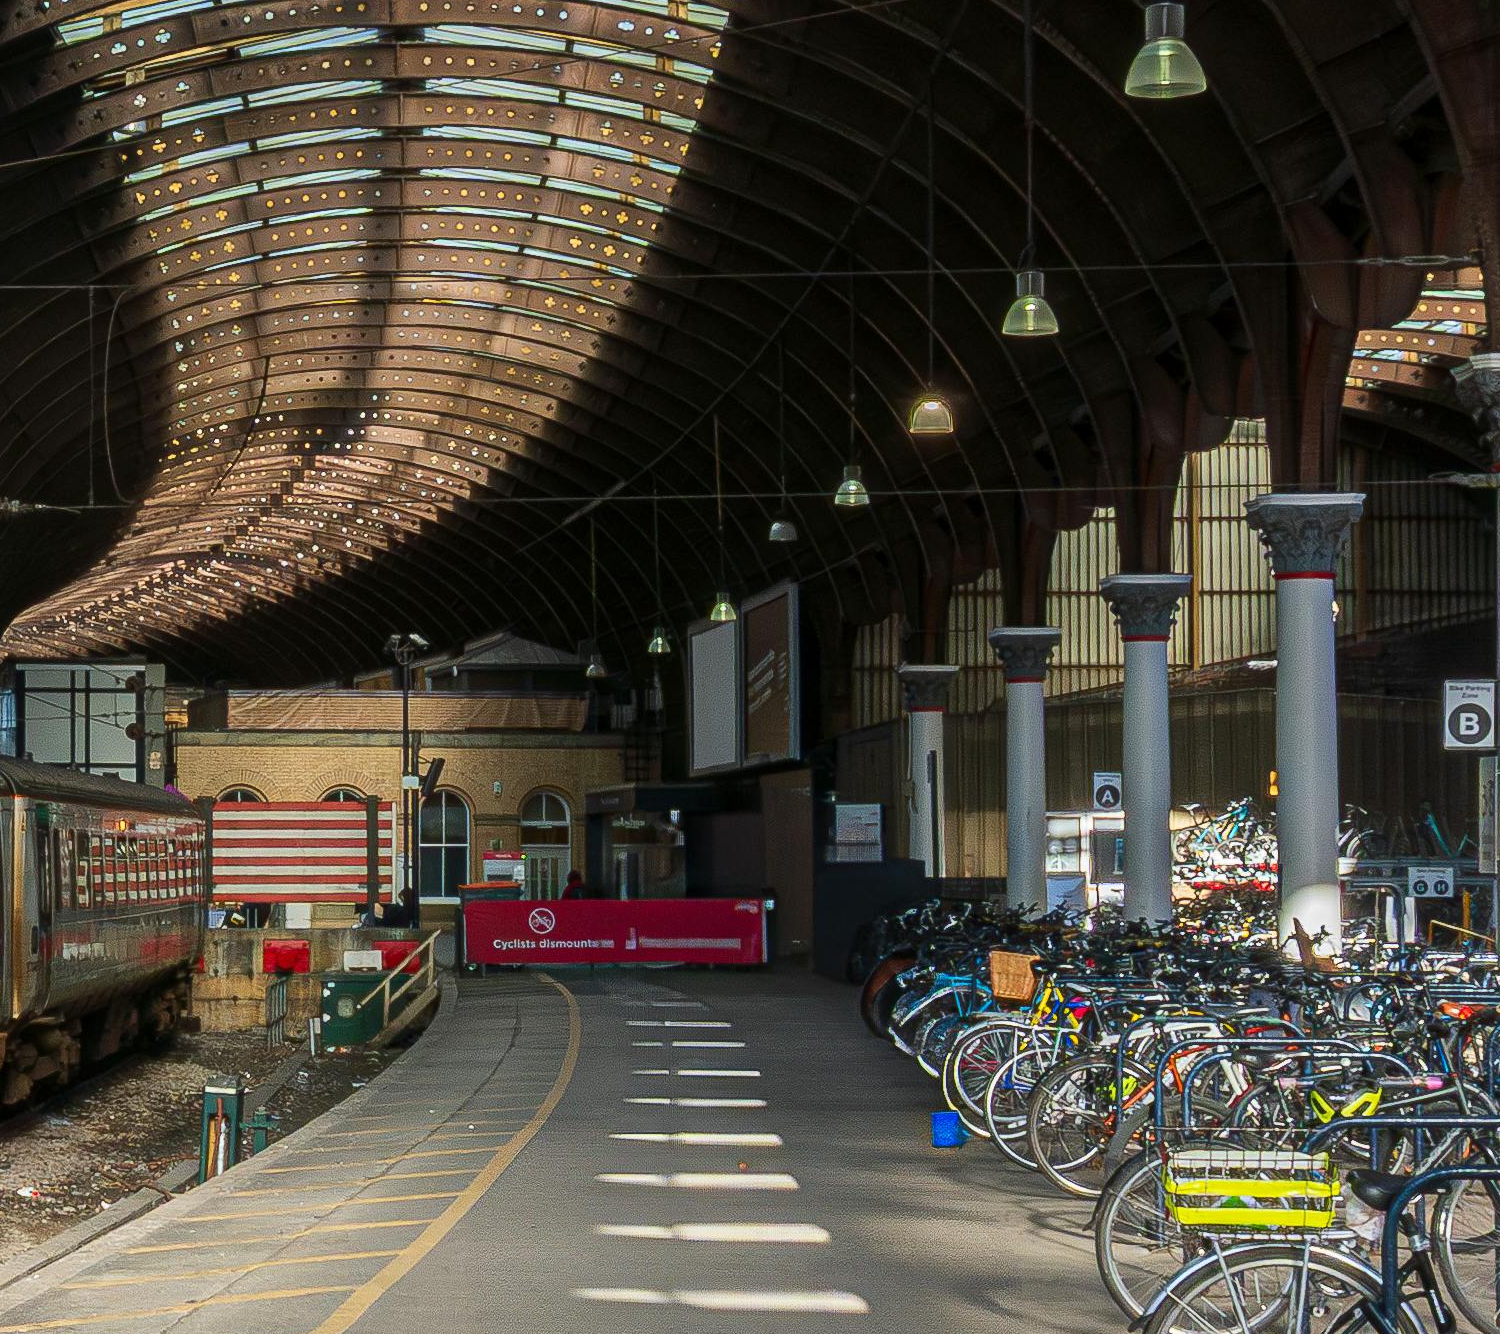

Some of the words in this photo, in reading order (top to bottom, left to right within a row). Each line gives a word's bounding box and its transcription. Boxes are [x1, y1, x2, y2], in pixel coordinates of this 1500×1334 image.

[1459, 713, 1479, 735] B
[1101, 789, 1114, 803] A
[493, 938, 536, 951] Cyclists
[539, 938, 591, 948] dismount
